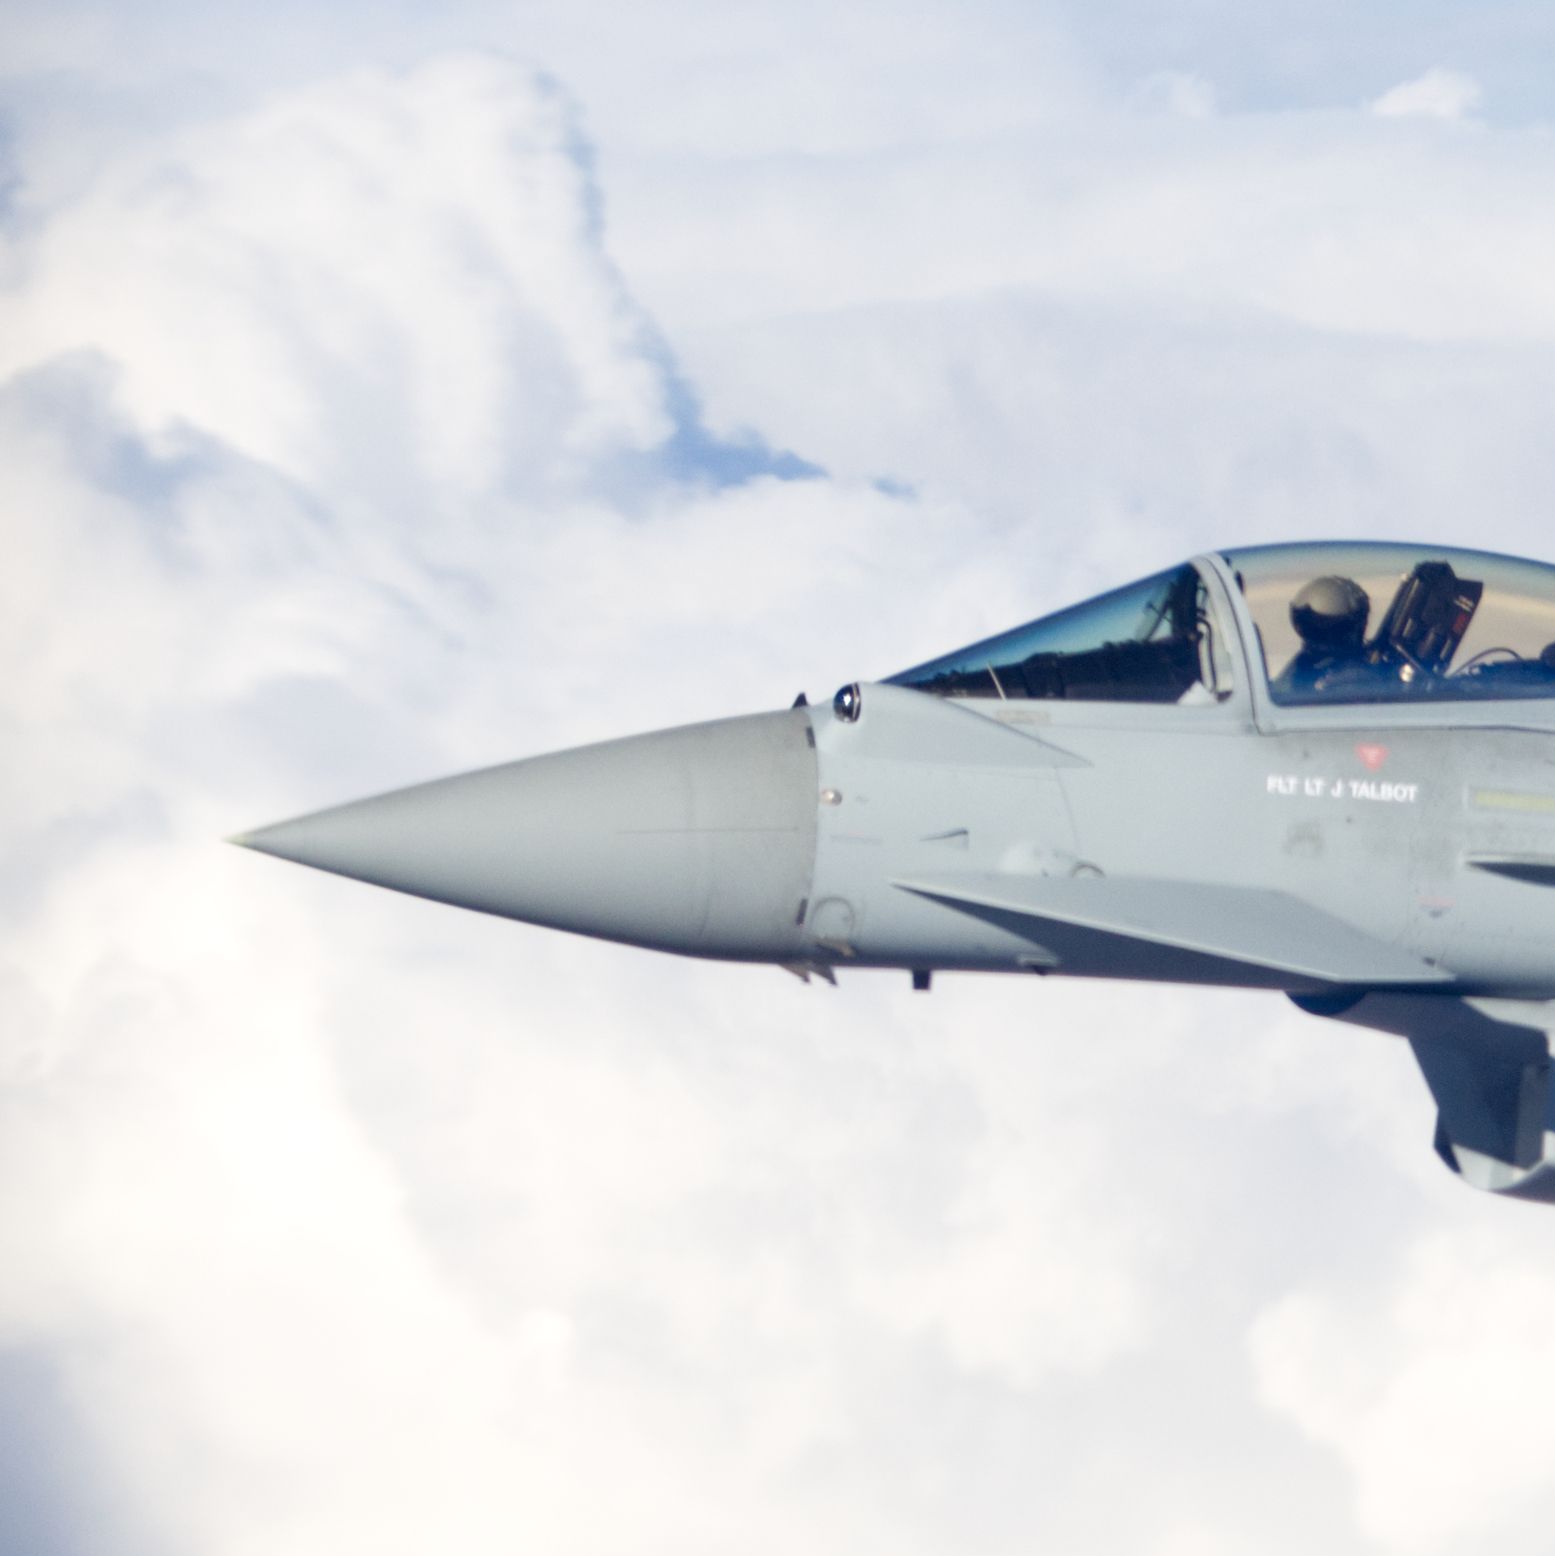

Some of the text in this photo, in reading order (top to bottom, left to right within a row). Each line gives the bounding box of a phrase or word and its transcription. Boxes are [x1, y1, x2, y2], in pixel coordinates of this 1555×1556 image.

[1266, 775, 1418, 803] FLT LT J TALBOT
